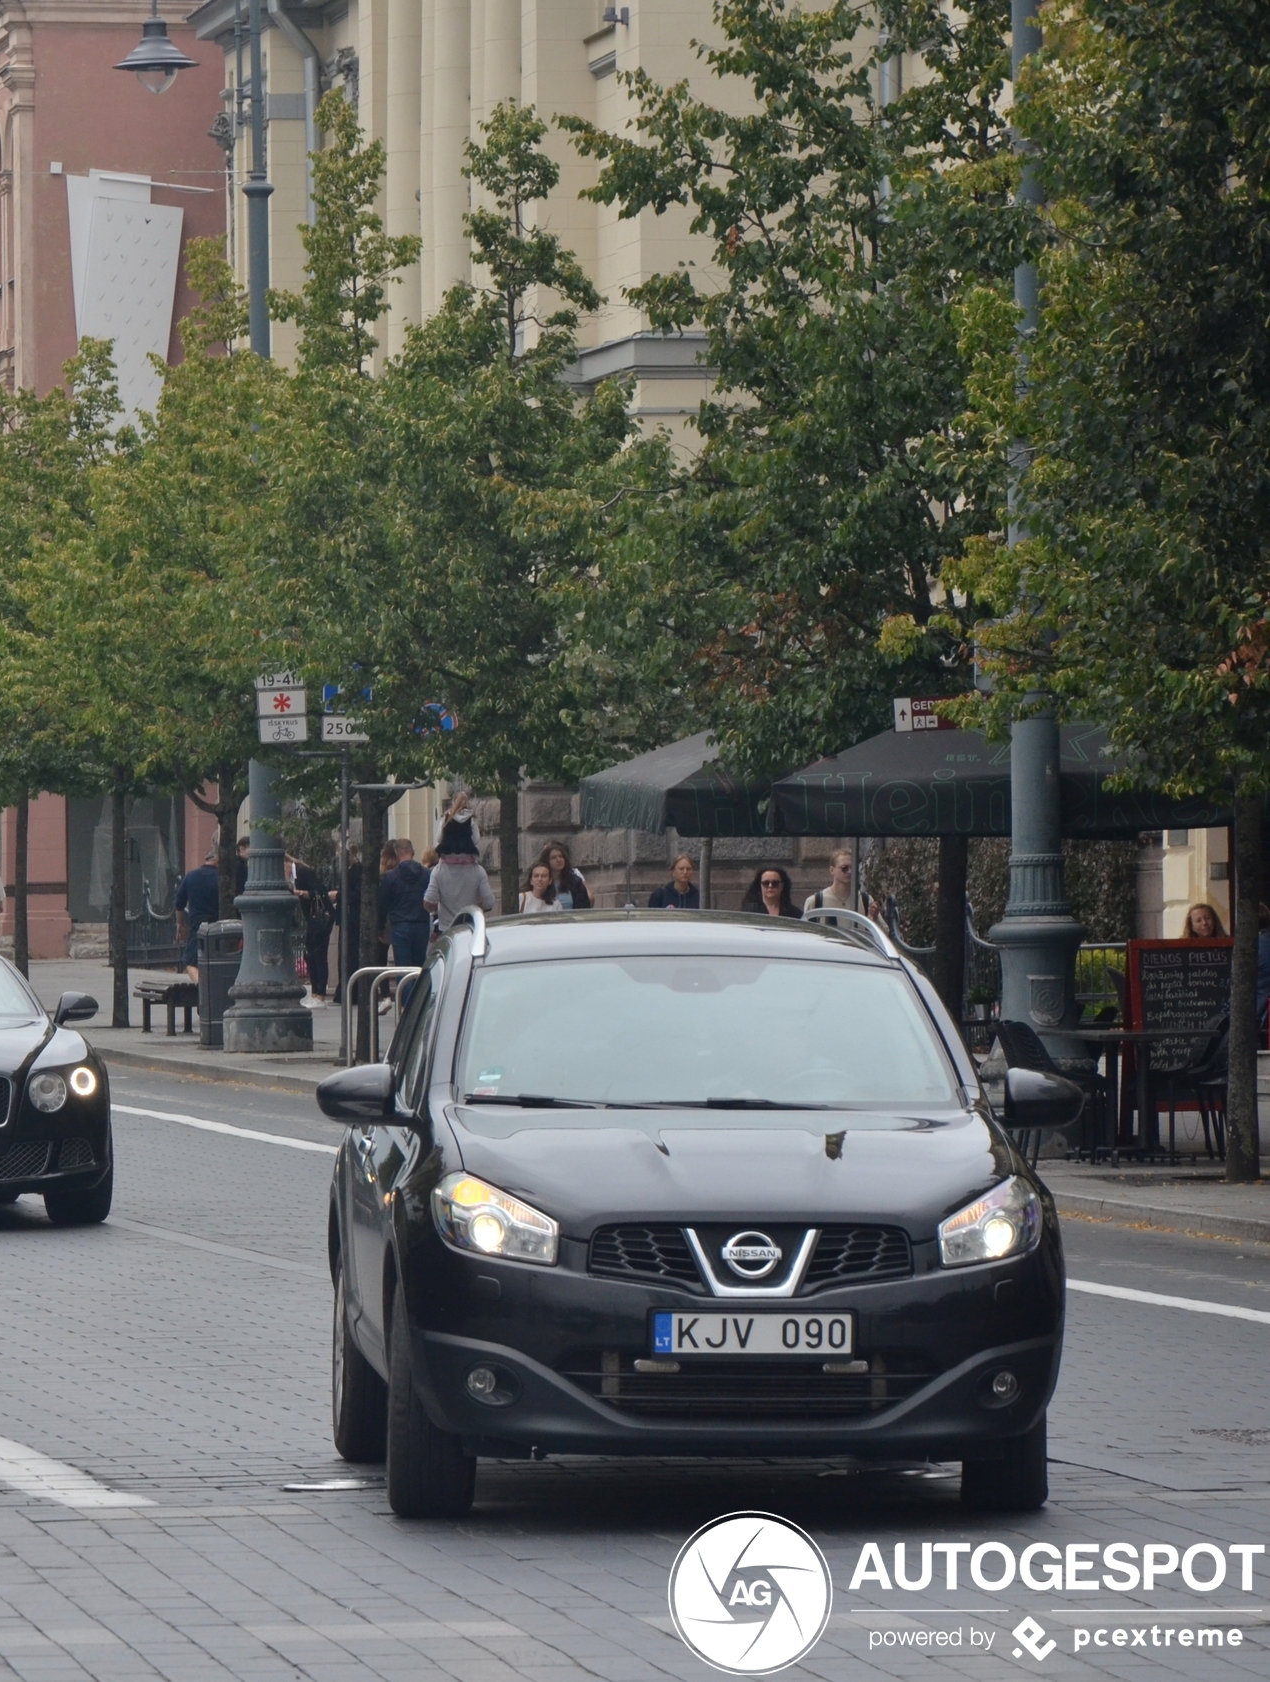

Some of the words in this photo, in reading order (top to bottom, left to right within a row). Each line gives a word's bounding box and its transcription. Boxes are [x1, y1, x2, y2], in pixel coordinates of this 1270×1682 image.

[268, 719, 298, 727] IŠSKYRUS
[1142, 952, 1182, 965] DIENOS
[1188, 949, 1228, 963] PIETŪS
[729, 1249, 776, 1257] NISSAN
[655, 1337, 671, 1346] LT
[677, 1318, 754, 1348] KJV
[782, 1318, 846, 1348] 090
